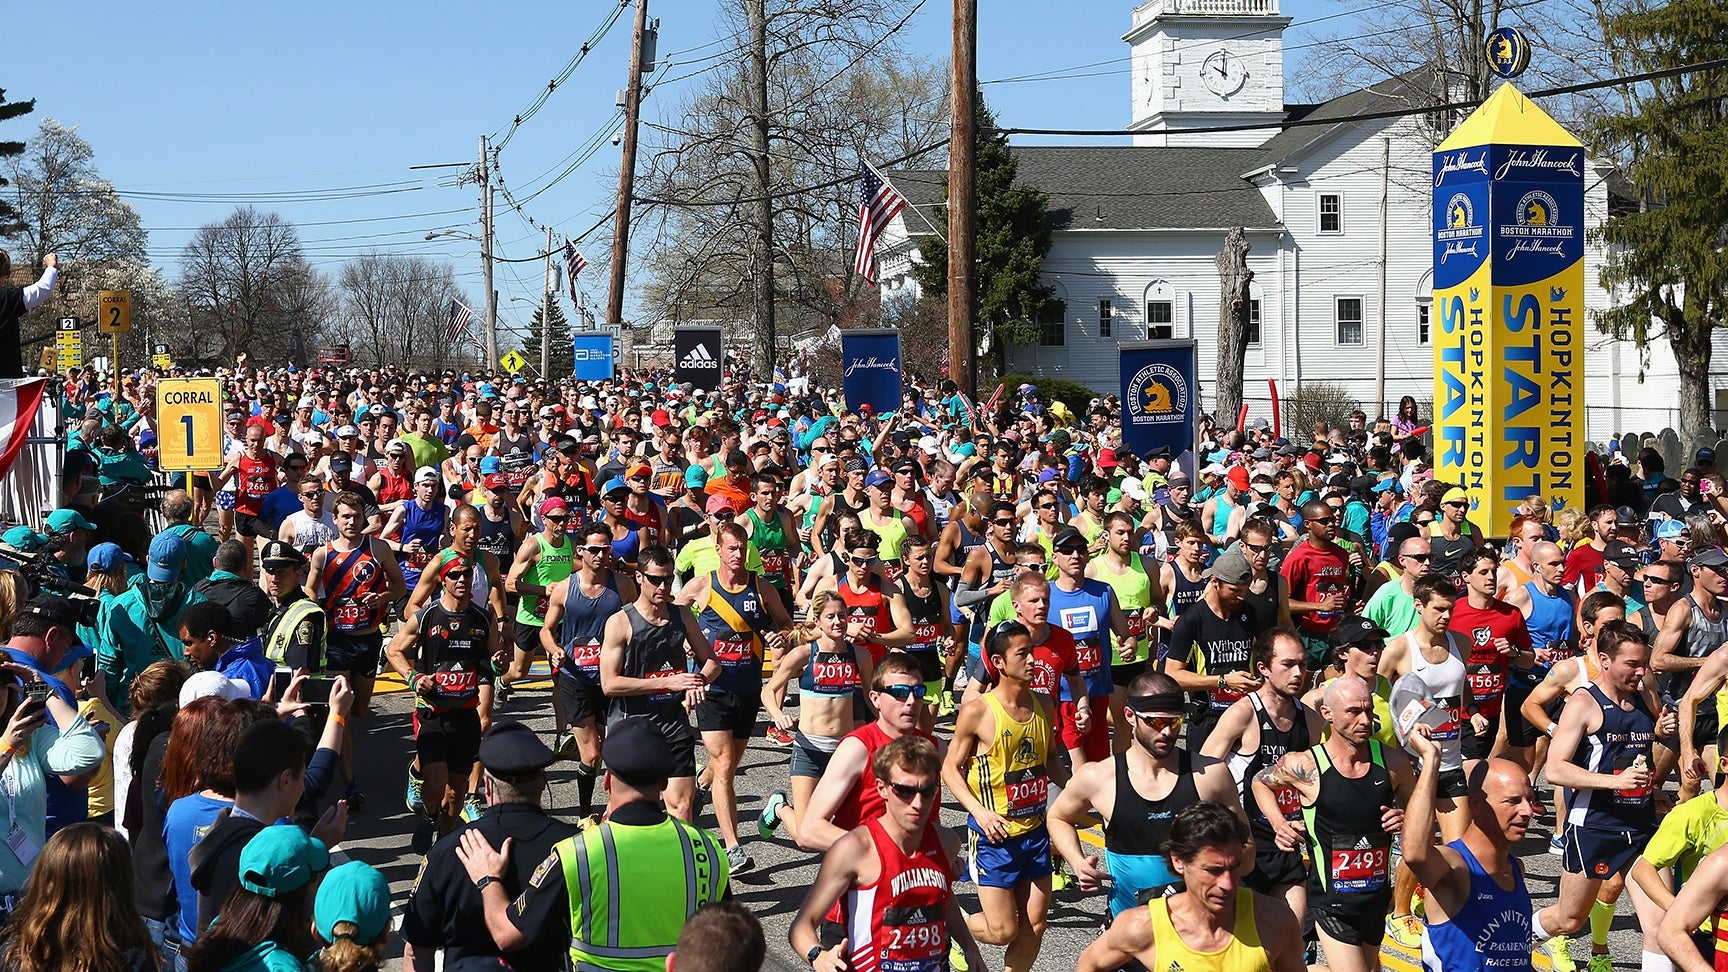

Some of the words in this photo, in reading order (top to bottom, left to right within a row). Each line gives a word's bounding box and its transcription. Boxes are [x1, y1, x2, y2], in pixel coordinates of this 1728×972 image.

[1435, 155, 1457, 188] John
[1455, 151, 1489, 176] Hancock
[1495, 149, 1530, 181] John
[1528, 148, 1581, 178] Hancock
[1437, 230, 1456, 240] BOSTON
[1455, 228, 1482, 239] MARATHON
[1500, 226, 1530, 236] BOSTON
[1531, 226, 1573, 236] MARATHON
[1505, 239, 1532, 261] John
[1529, 239, 1566, 258] Hancock
[64, 319, 72, 328] 2
[109, 307, 121, 327] 2
[45, 355, 53, 365] 3
[679, 358, 717, 369] adidas
[845, 358, 866, 377] John
[864, 356, 899, 372] Hancock
[1130, 383, 1139, 411] BOSTON
[1136, 366, 1165, 384] ATHLETIC
[1164, 367, 1187, 408] ASSOCIATION
[164, 391, 213, 405] CORRAL
[1470, 308, 1484, 489] HOPKINTON
[1549, 308, 1572, 489] HOPKINTON
[1132, 415, 1155, 423] BOSTON
[1155, 413, 1185, 422] MARATHON
[180, 415, 194, 456] 1
[161, 456, 184, 464] oston
[186, 455, 217, 464] Marath
[249, 482, 269, 491] 2666
[408, 553, 432, 563] 2125
[336, 606, 366, 619] 2135
[743, 600, 756, 612] BQ
[916, 625, 935, 636] 469
[718, 641, 751, 655] 2744
[1207, 639, 1251, 651] Without
[1077, 648, 1098, 663] 241
[1210, 650, 1249, 665] Limits
[817, 664, 852, 678] 2019
[440, 672, 474, 686] 2977
[1468, 674, 1500, 688] 1565
[1010, 779, 1046, 801] 2042
[1277, 789, 1299, 805] 434
[1338, 850, 1384, 870] 2493
[693, 839, 708, 908] POLIC
[890, 868, 948, 898] WILLIAMSON
[888, 924, 940, 950] 2498
[1474, 918, 1500, 953] RUN
[1500, 909, 1529, 930] WITH
[881, 949, 887, 957] 3
[1485, 957, 1510, 967] RACE
